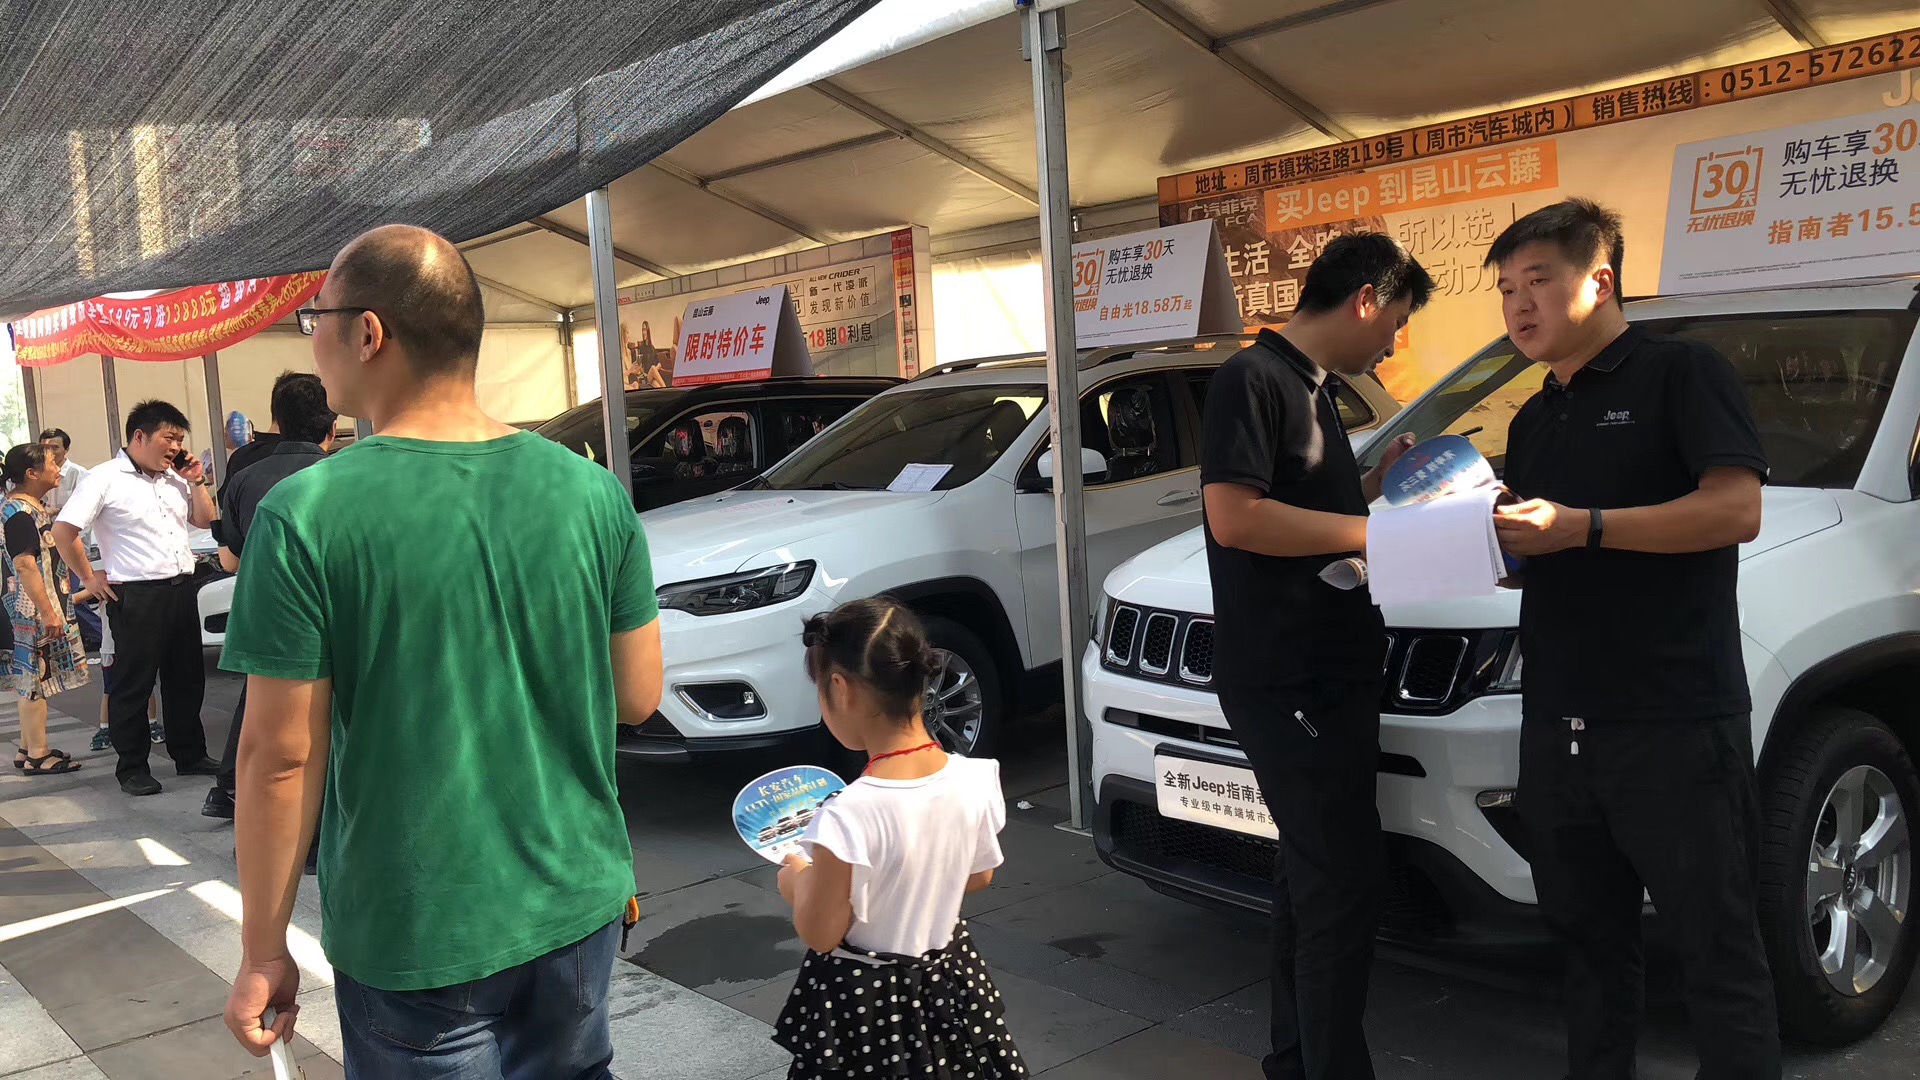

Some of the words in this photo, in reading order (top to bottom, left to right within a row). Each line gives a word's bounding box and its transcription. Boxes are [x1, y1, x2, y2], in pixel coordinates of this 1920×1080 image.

[1784, 118, 1920, 167] 购车享30
[1277, 185, 1370, 224] 买Jeep
[1379, 146, 1542, 206] 到昆山云藤
[1779, 157, 1900, 199] 无忧退换
[1187, 196, 1258, 222] 广汽菲克
[1225, 214, 1257, 227] FCA
[1686, 209, 1756, 234] 无忧退换
[1108, 239, 1176, 266] 购车享30天
[828, 268, 860, 280] CRIDER
[1105, 262, 1153, 285] 无忧退换
[755, 295, 770, 305] Jeep
[809, 292, 870, 315] 发现新价值
[1100, 295, 1192, 321] 自由光18.58万起
[684, 323, 767, 362] 限时特价车
[1603, 410, 1630, 420] Jeep
